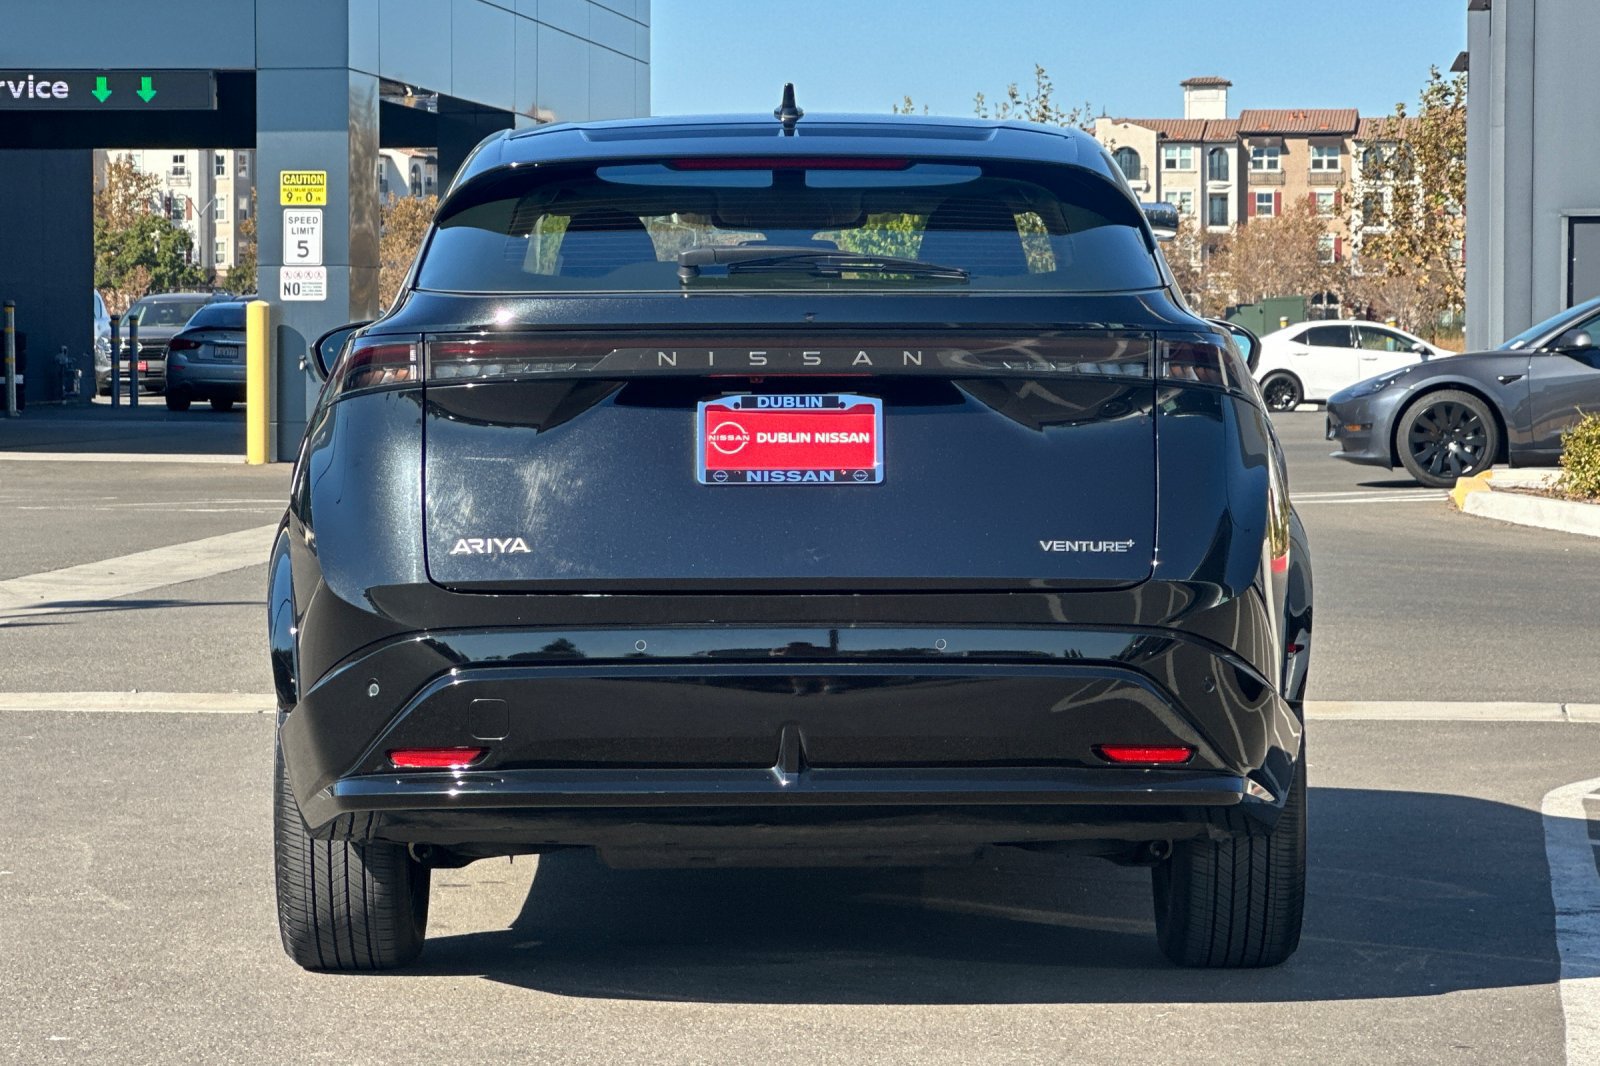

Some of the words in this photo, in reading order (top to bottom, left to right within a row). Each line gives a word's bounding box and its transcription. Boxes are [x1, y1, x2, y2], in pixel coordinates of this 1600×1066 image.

[284, 174, 324, 185] CAUTION
[287, 191, 293, 202] 9
[305, 191, 313, 202] 0
[288, 216, 319, 225] SPEED
[291, 227, 316, 235] LIMIT
[297, 240, 309, 258] 5
[283, 282, 301, 296] NO
[657, 351, 922, 366] NISSAN
[757, 396, 823, 408] DUBLIN
[756, 432, 811, 443] DUBLIN
[815, 432, 870, 443] NISSAN
[746, 470, 835, 482] NISSAN
[449, 537, 532, 555] ARIYA
